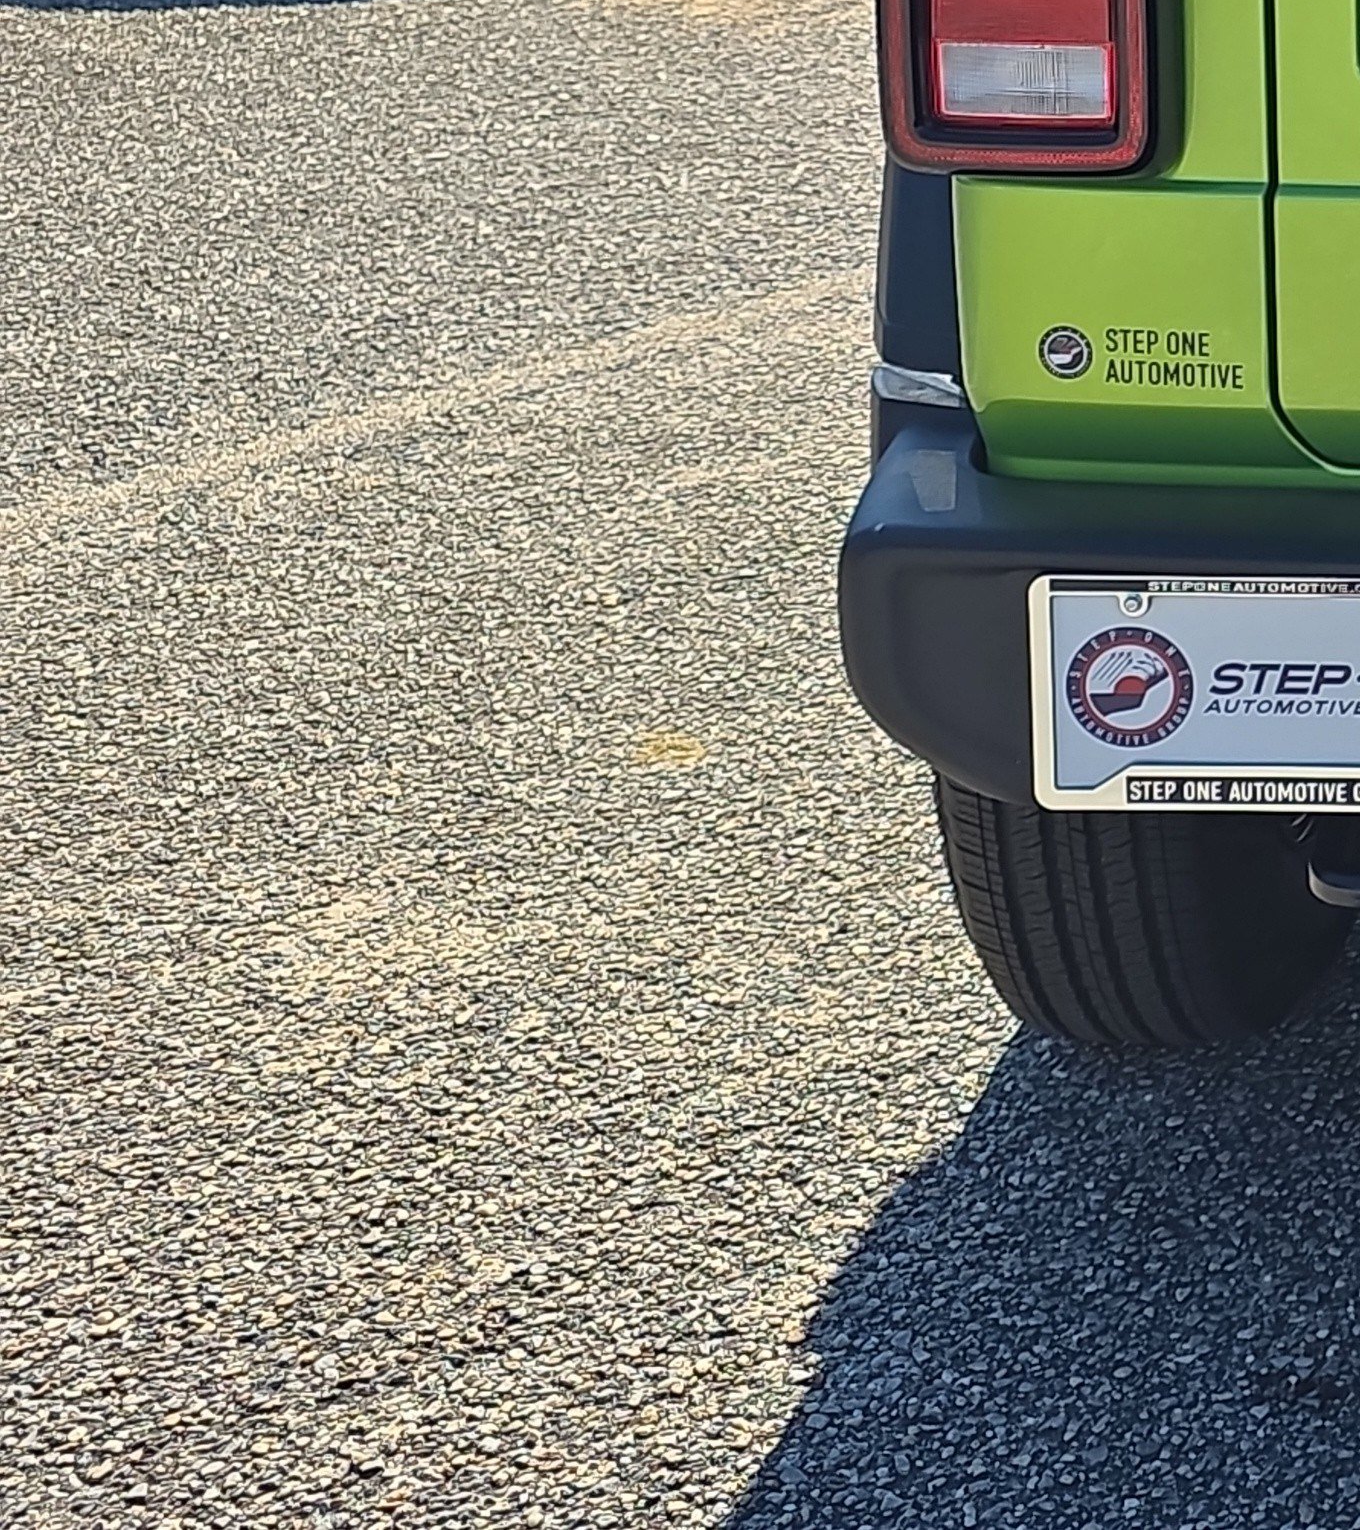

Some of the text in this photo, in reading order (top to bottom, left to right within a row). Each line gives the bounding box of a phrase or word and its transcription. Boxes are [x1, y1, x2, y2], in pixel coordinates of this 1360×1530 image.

[1105, 328, 1159, 355] STEP
[1166, 331, 1210, 357] ONE
[1105, 359, 1244, 390] AUTOMOTIVE
[1129, 780, 1175, 801] STEP
[1183, 780, 1223, 802] ONE
[1228, 781, 1348, 804] AUTOMOTIVE
